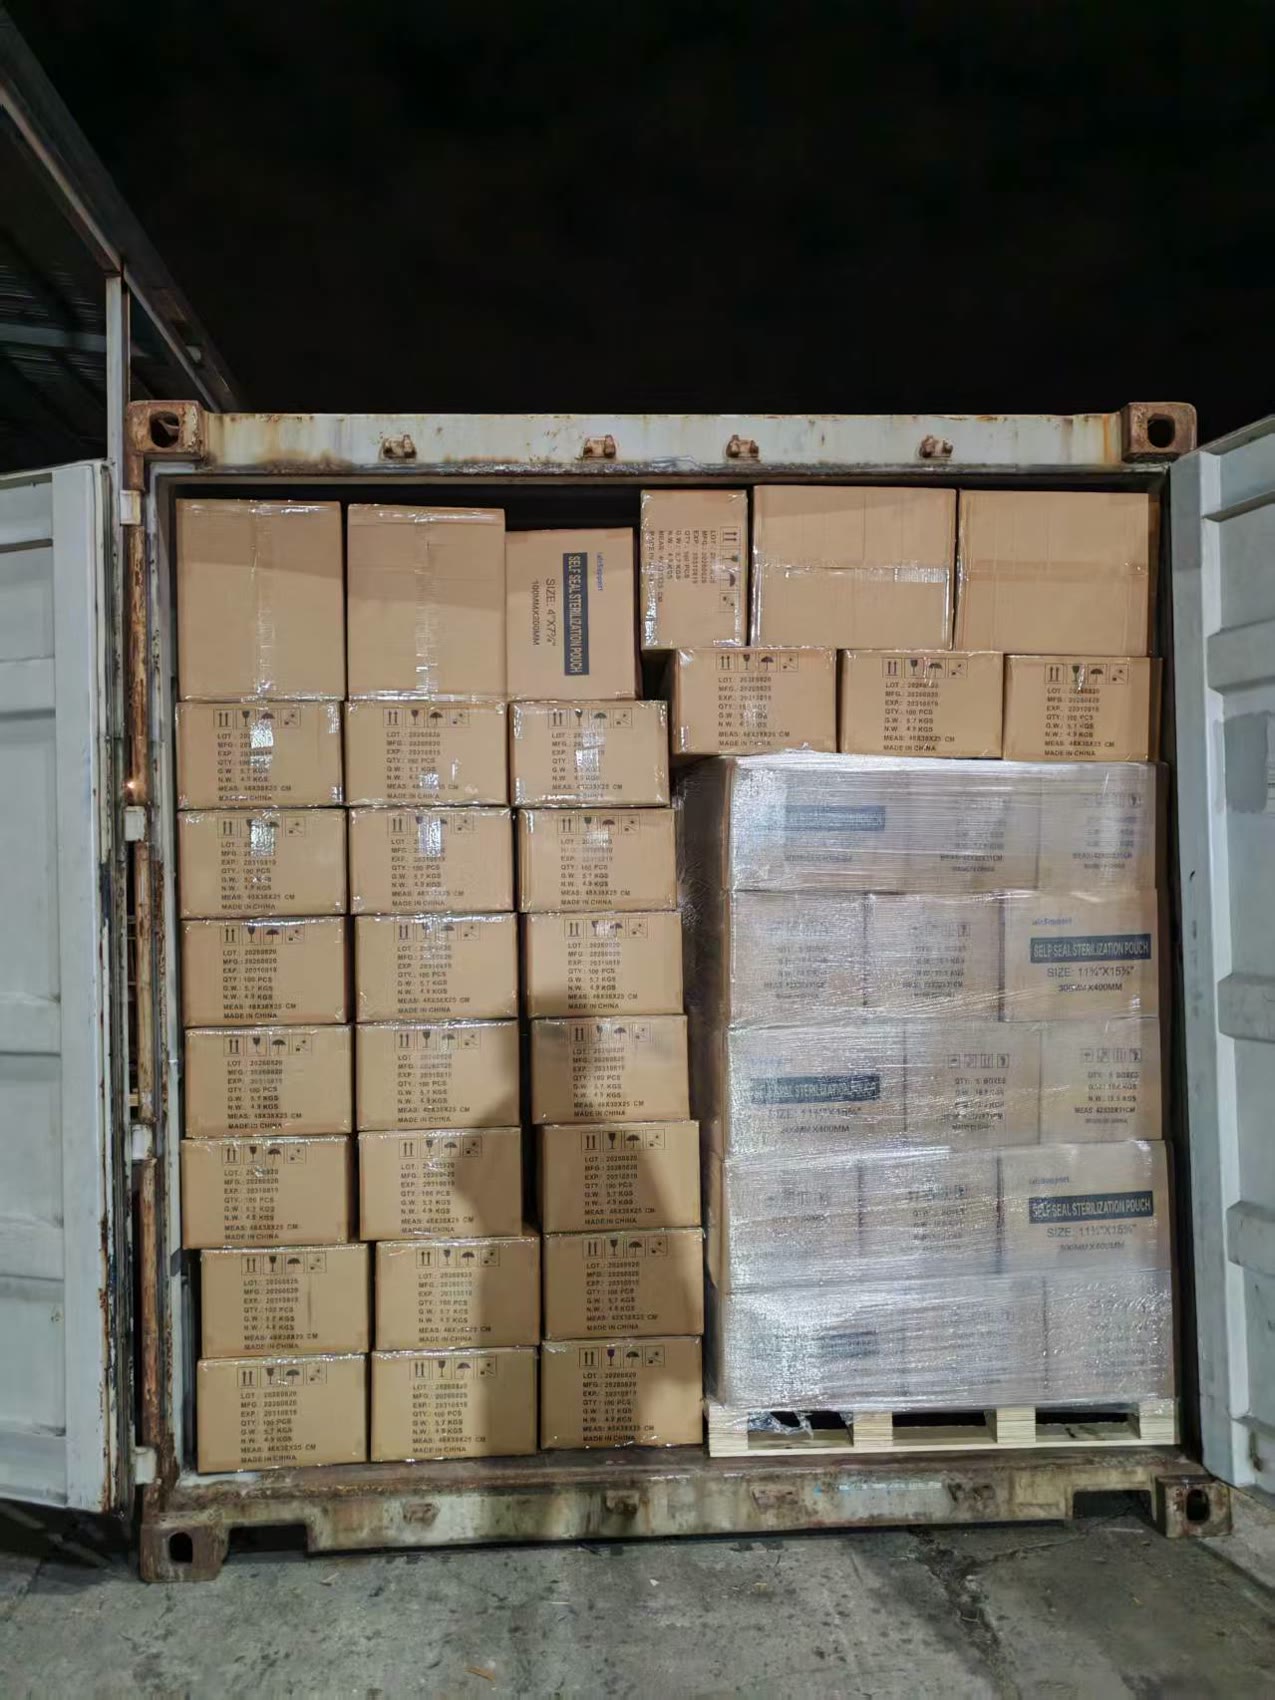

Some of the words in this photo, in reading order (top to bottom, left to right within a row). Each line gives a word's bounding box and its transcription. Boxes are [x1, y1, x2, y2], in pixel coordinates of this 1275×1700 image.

[568, 555, 581, 574] SELF
[568, 575, 581, 593] SEAL
[569, 594, 583, 647] STERILIZATION
[569, 647, 583, 673] POUCH
[1053, 943, 1072, 957] SEAL
[1073, 942, 1124, 956] STERILIZATION
[1124, 941, 1149, 955] POUCH
[1053, 1202, 1072, 1217] SEAL
[1072, 1200, 1125, 1216] STERILIZATION
[1126, 1198, 1151, 1212] POUCH
